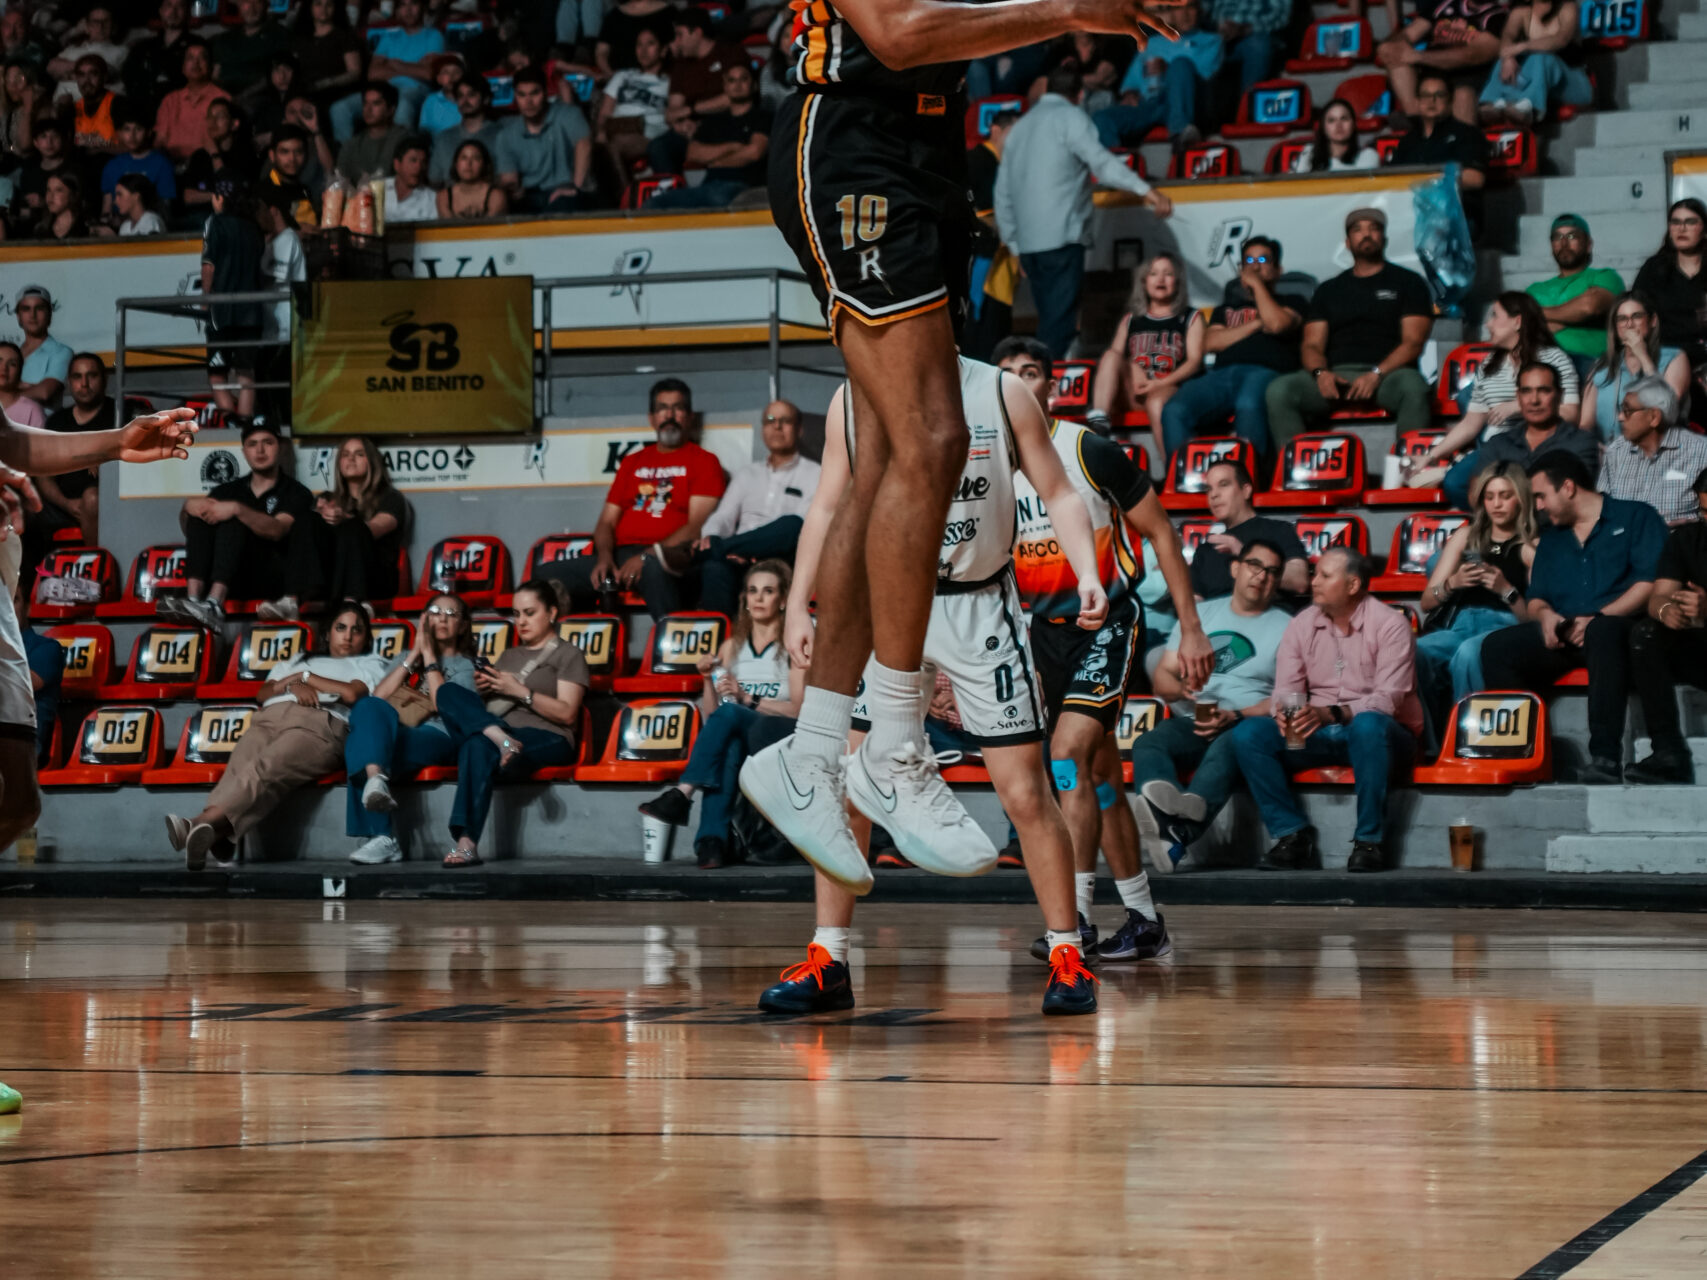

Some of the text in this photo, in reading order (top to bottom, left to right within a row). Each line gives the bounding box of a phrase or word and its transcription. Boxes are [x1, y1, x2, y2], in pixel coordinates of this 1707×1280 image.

[1587, 1, 1638, 34] 015
[835, 194, 888, 251] 10
[366, 374, 484, 392] SAN BENITO
[1060, 375, 1086, 399] 08
[384, 449, 449, 471] ARCO
[156, 639, 190, 664] 014
[259, 637, 293, 662] 013
[375, 636, 396, 661] 12
[670, 629, 713, 659] 009
[994, 663, 1014, 703] 0
[1073, 670, 1111, 687] MEGA
[102, 720, 139, 745] 013
[207, 718, 244, 744] 012
[637, 714, 681, 742] 008
[1119, 713, 1149, 740] 04
[1479, 707, 1521, 736] 001
